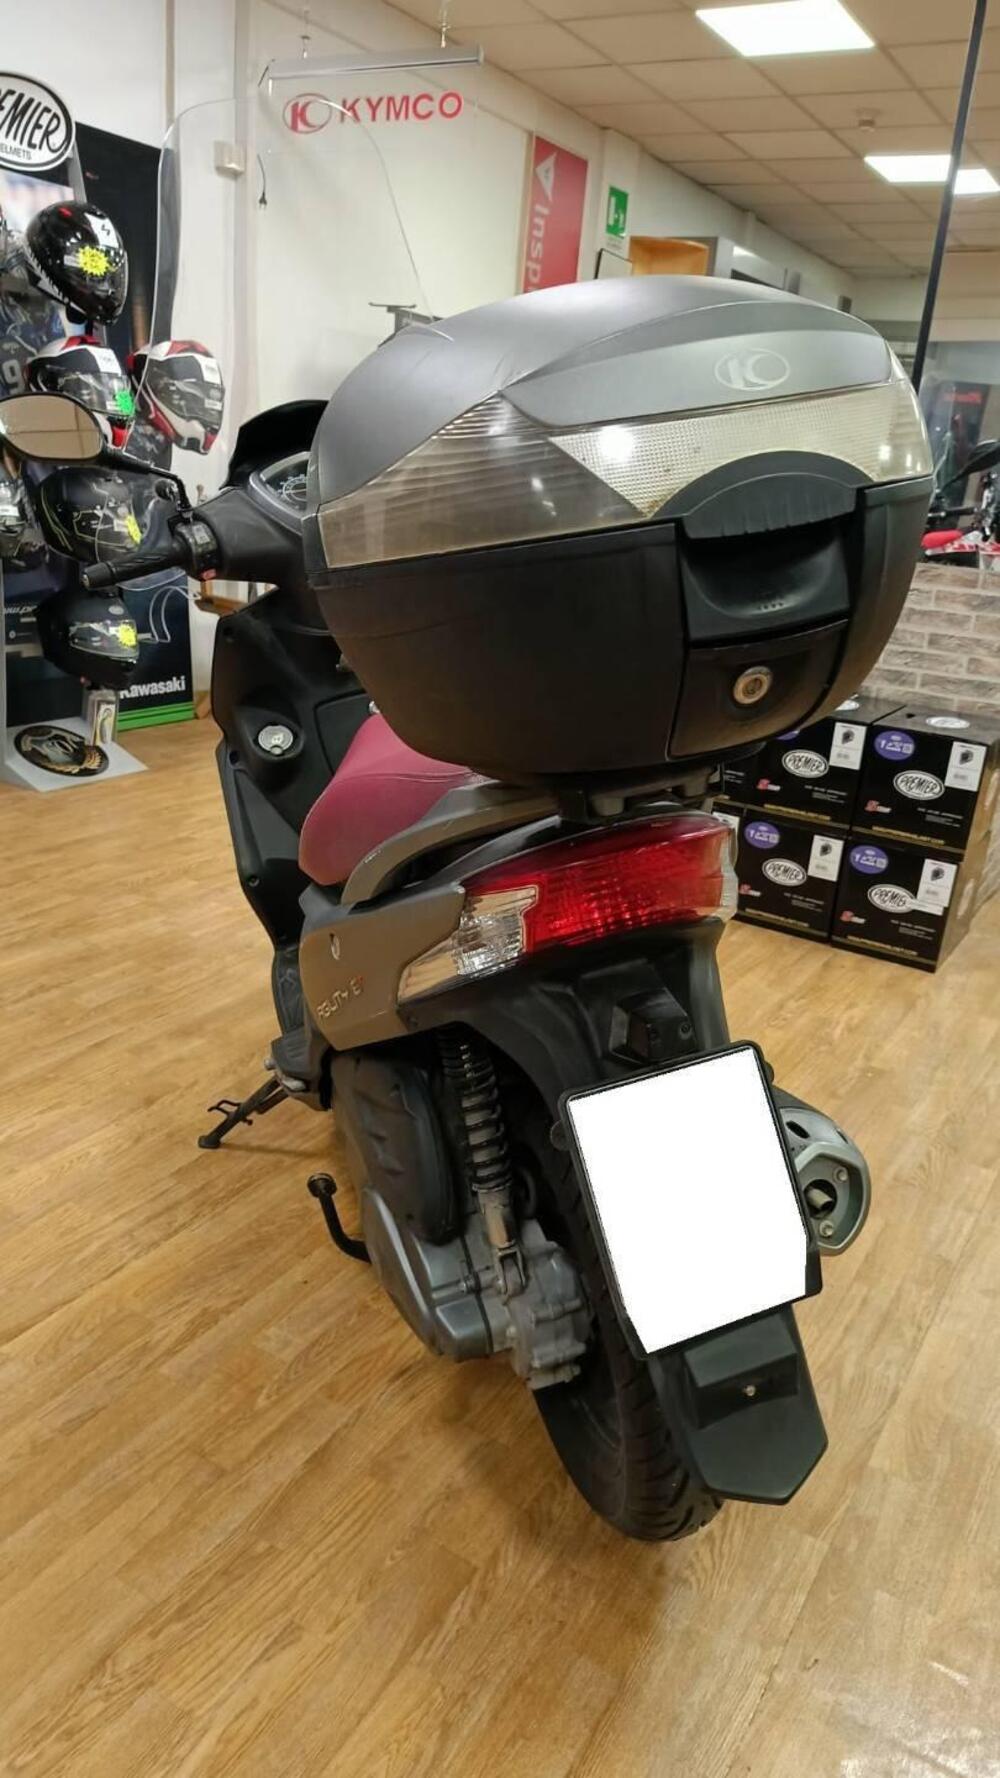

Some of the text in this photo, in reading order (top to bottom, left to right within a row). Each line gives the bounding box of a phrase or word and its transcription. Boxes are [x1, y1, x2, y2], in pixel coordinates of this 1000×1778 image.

[340, 91, 463, 124] KYMCO
[525, 203, 550, 291] Insp
[899, 773, 940, 796] PREMIER
[872, 886, 907, 908] PREMIE
